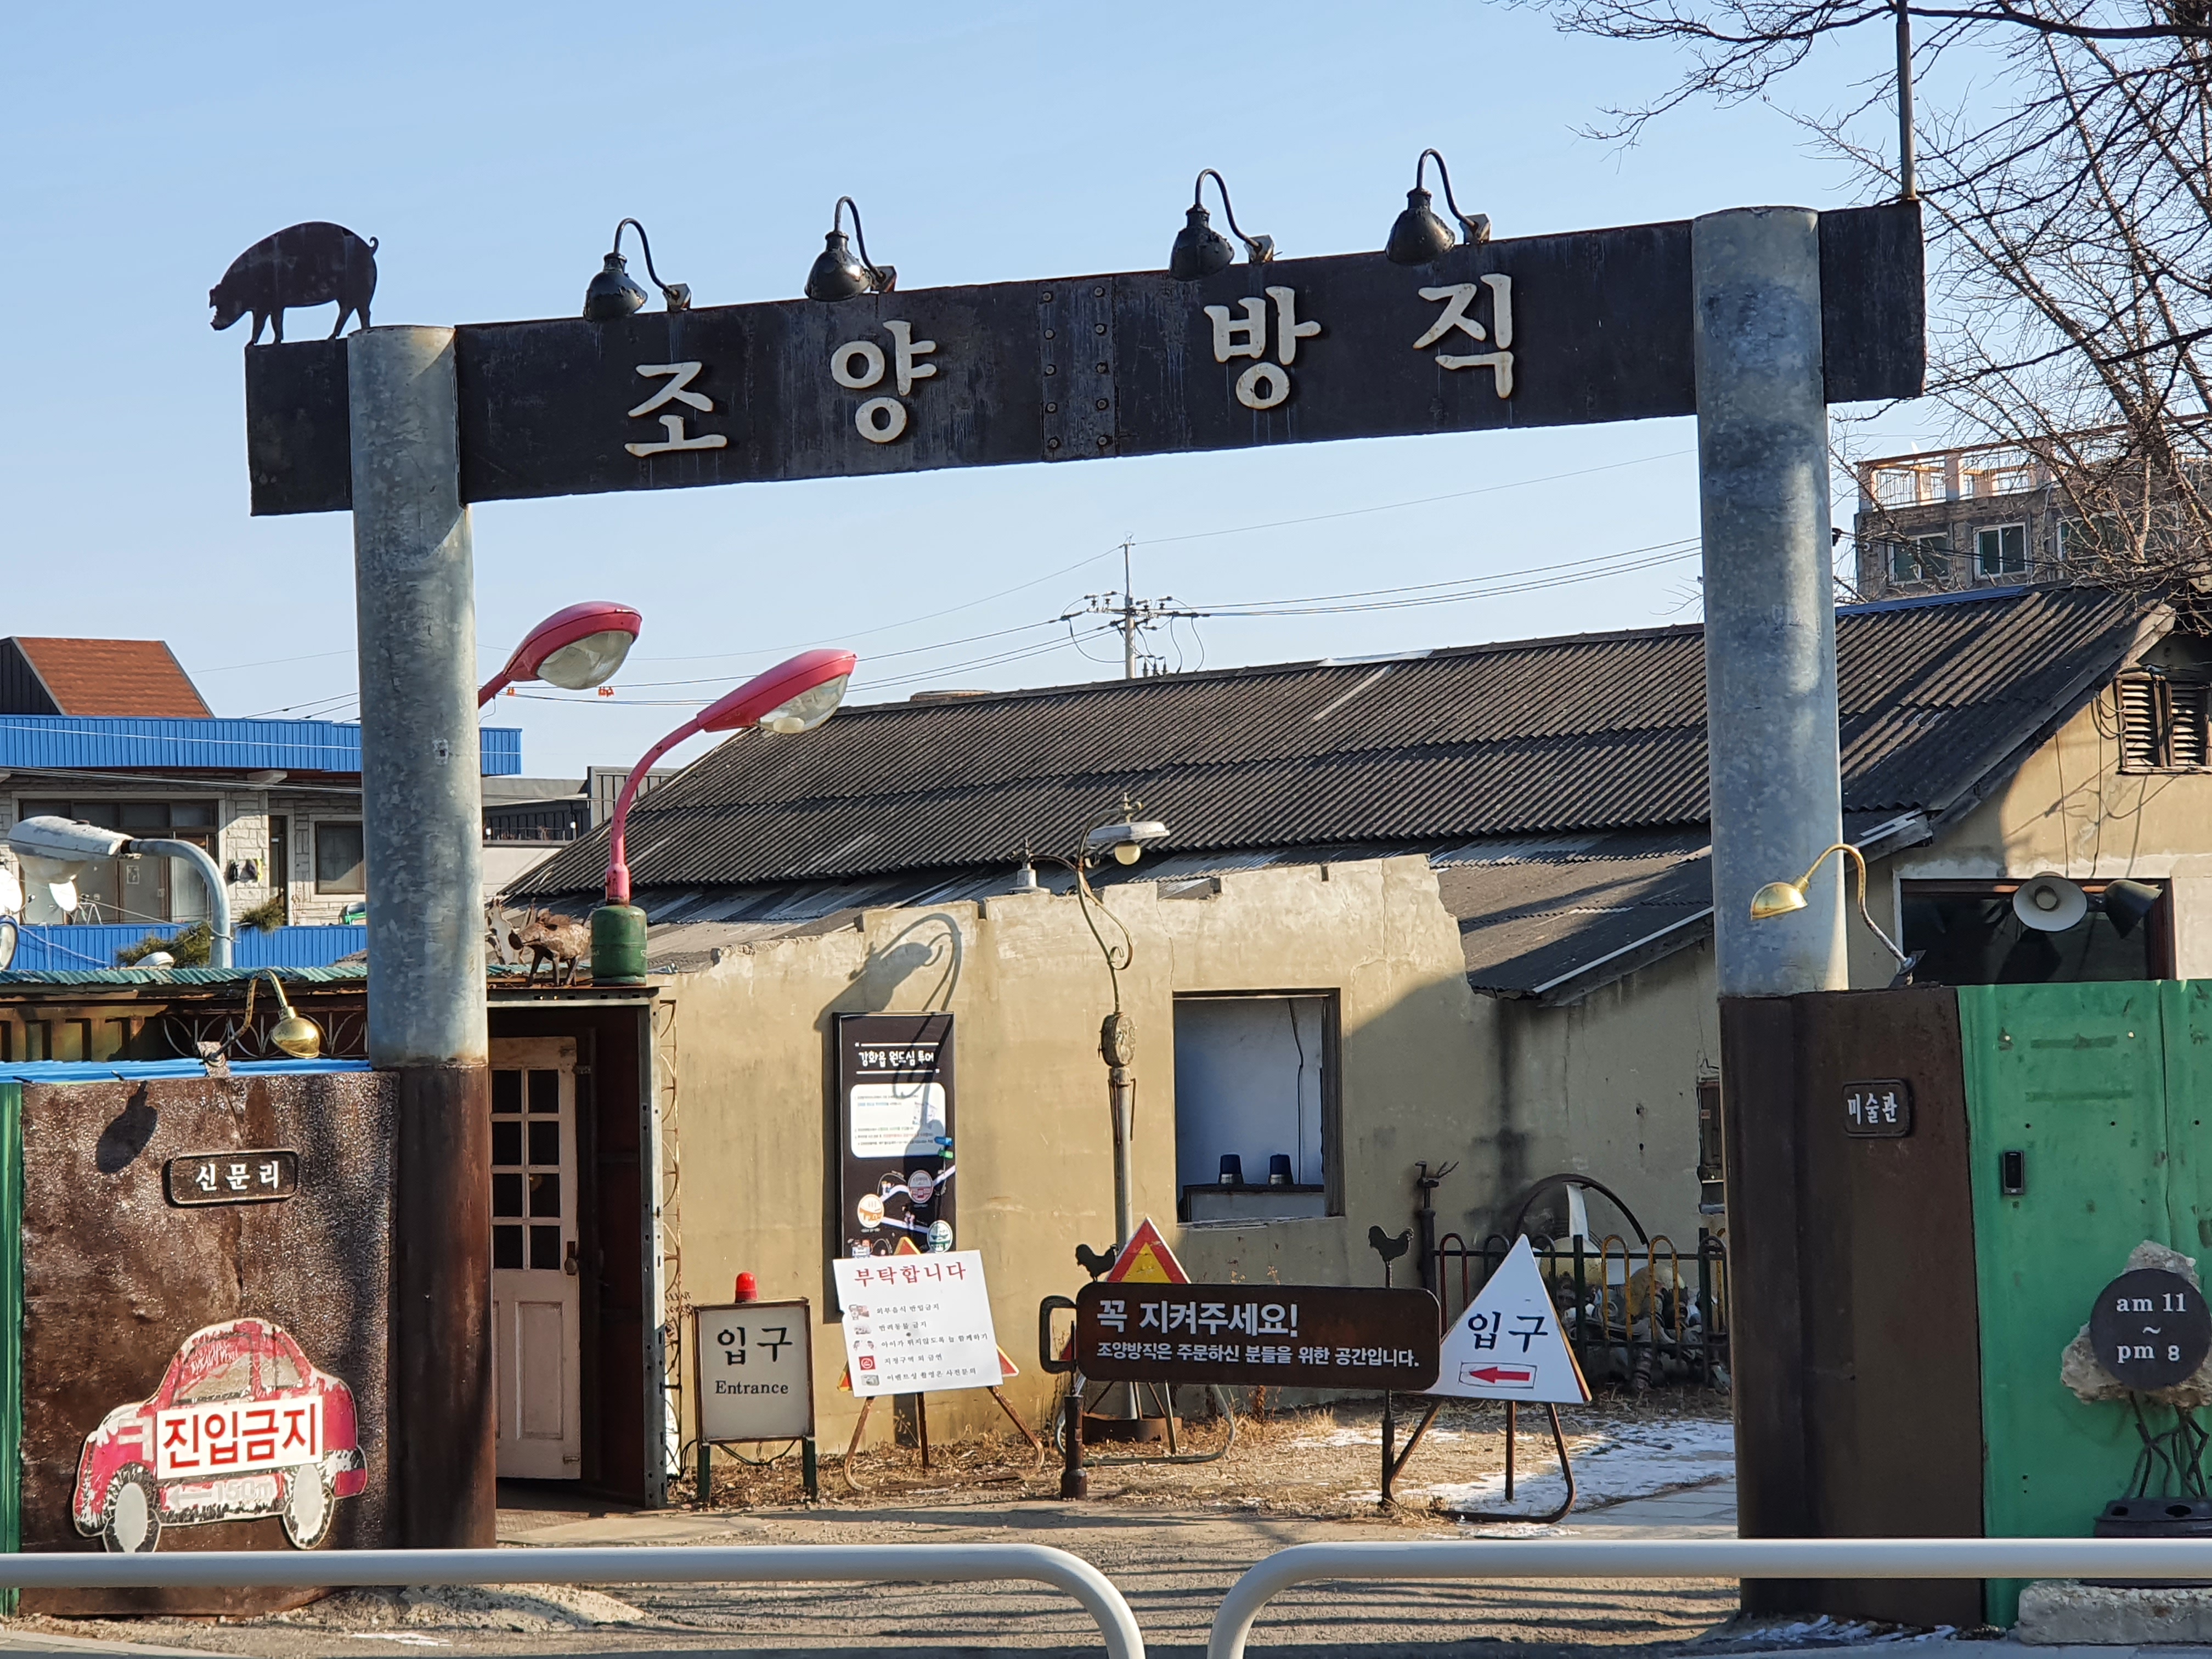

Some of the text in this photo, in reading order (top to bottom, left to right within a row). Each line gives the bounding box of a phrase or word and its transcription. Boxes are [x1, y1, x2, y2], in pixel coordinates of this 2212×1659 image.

[858, 1050, 887, 1068] 강화읍
[918, 1049, 934, 1064] 투어
[1847, 1091, 1898, 1125] 미술관
[195, 1160, 279, 1191] 신문리
[854, 1261, 966, 1288] 부탁합니다
[2116, 1293, 2186, 1312] am 11
[1097, 1300, 1298, 1338] 꼭 지켜주세요!
[1468, 1311, 1548, 1353] 입구
[717, 1327, 793, 1365] 입구
[1097, 1341, 1420, 1367] 조양방직은 주문하신 분들을 위한 공간입니다.
[2117, 1344, 2180, 1363] pm 8
[715, 1380, 789, 1395] Entrance
[163, 1403, 316, 1469] 진입금지
